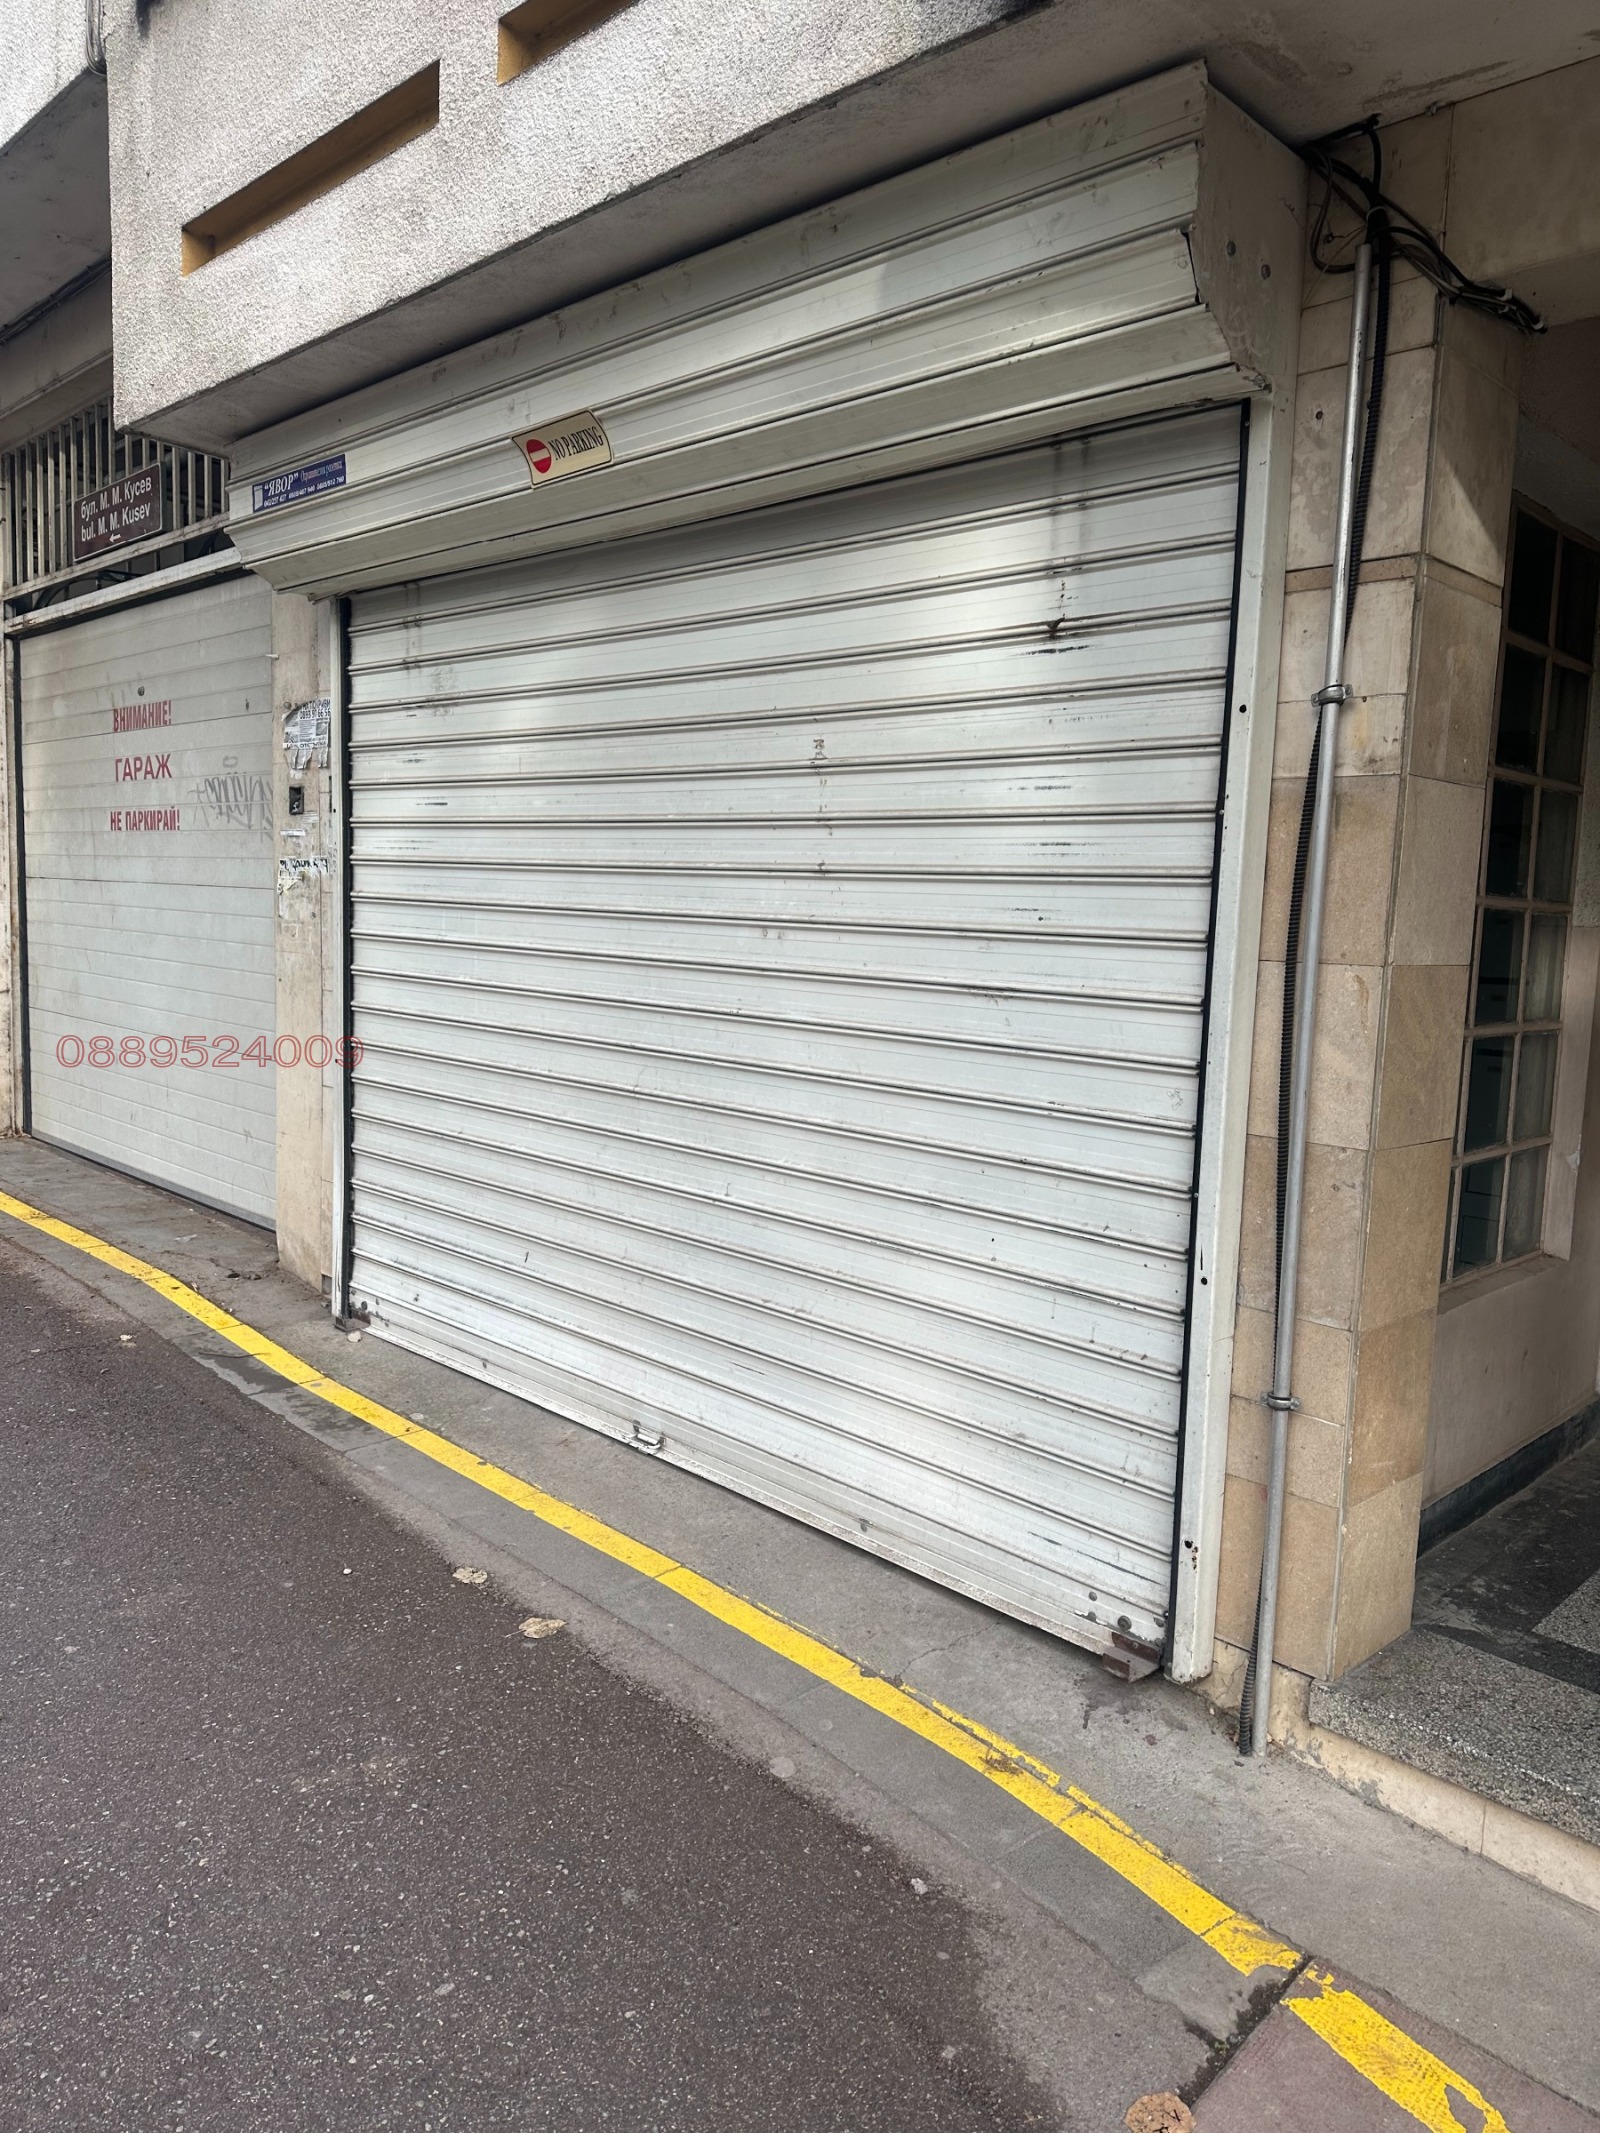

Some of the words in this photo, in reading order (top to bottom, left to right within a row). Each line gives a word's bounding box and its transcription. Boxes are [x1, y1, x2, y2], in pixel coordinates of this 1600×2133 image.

[548, 438, 567, 461] NO
[561, 426, 604, 457] PARKING
[81, 500, 98, 521] бул.
[100, 491, 110, 511] М.
[112, 485, 122, 506] М.
[124, 476, 152, 502] Кусев
[81, 522, 96, 542] bul.
[98, 516, 108, 535] M.
[110, 511, 120, 531] M.
[122, 502, 151, 526] Kusev
[113, 700, 172, 733] ВНИМАНИЕ!
[115, 753, 172, 782] ГАРАЖ
[110, 811, 122, 832] НЕ
[125, 805, 181, 831] ПАРКИРАЙ!
